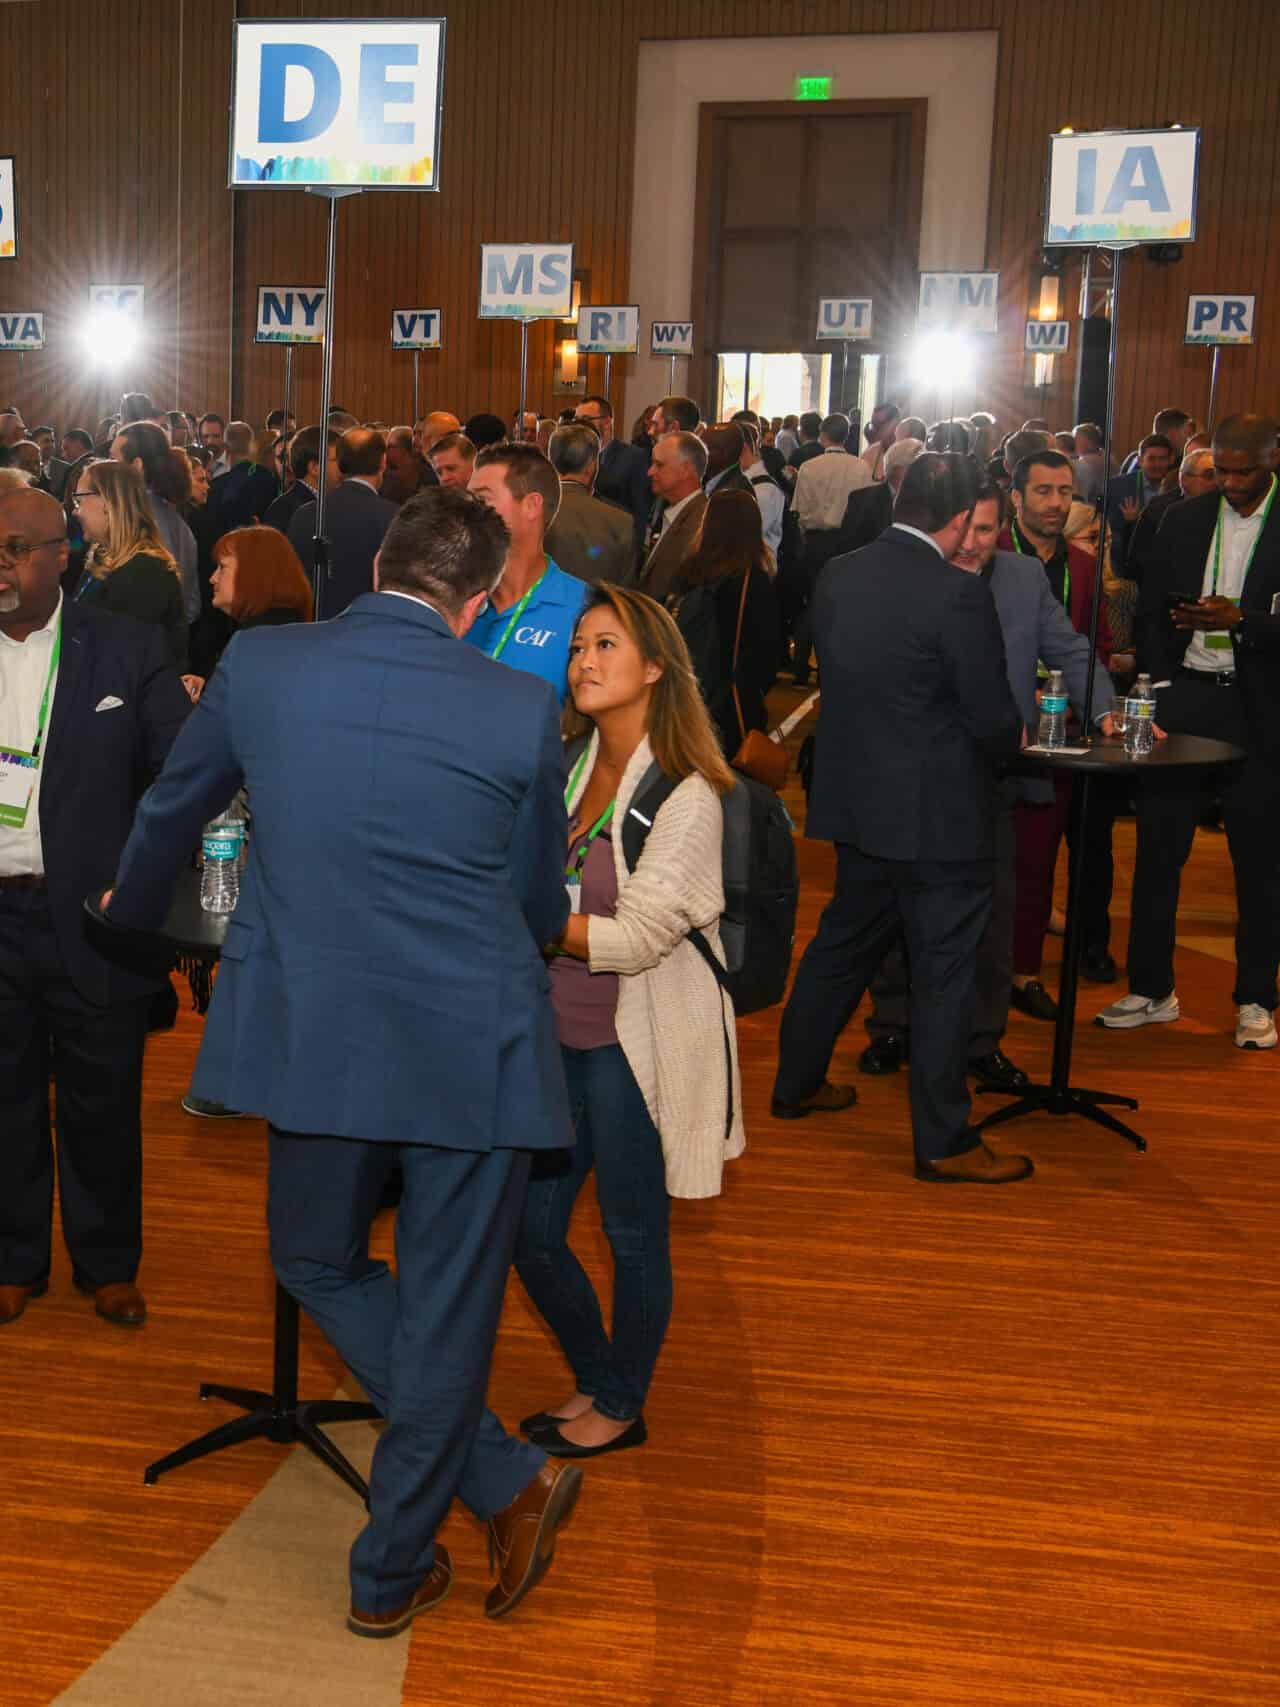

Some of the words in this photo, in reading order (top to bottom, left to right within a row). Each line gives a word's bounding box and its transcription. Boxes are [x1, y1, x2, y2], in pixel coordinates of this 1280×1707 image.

[257, 43, 419, 145] DE
[1074, 144, 1172, 215] IA
[486, 253, 569, 296] MS
[262, 291, 326, 326] NY
[823, 302, 869, 328] UT
[1192, 300, 1248, 332] PR
[0, 316, 42, 341] VA
[396, 313, 437, 339] VT
[589, 311, 627, 342] RI
[654, 325, 692, 343] WY
[1028, 324, 1067, 346] WI
